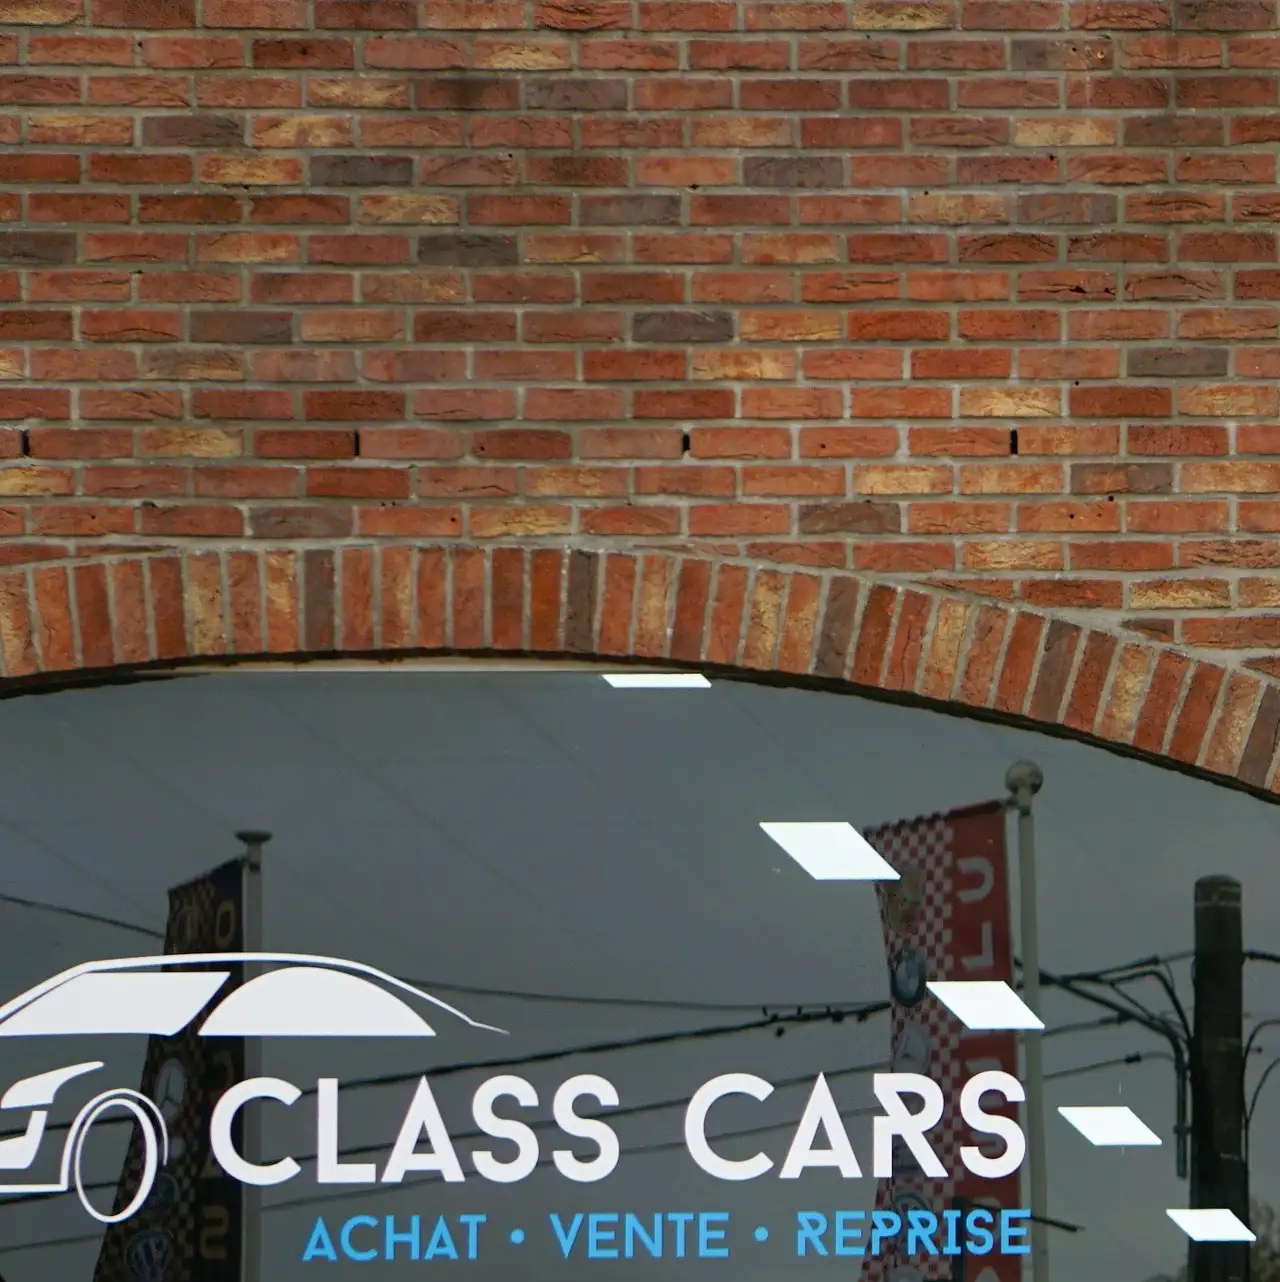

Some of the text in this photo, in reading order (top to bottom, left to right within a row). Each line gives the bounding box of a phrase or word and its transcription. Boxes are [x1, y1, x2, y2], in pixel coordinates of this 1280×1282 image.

[210, 1071, 1026, 1186] CLASS CARS
[303, 1209, 1032, 1261] ACHAT VENTE REPRISE
